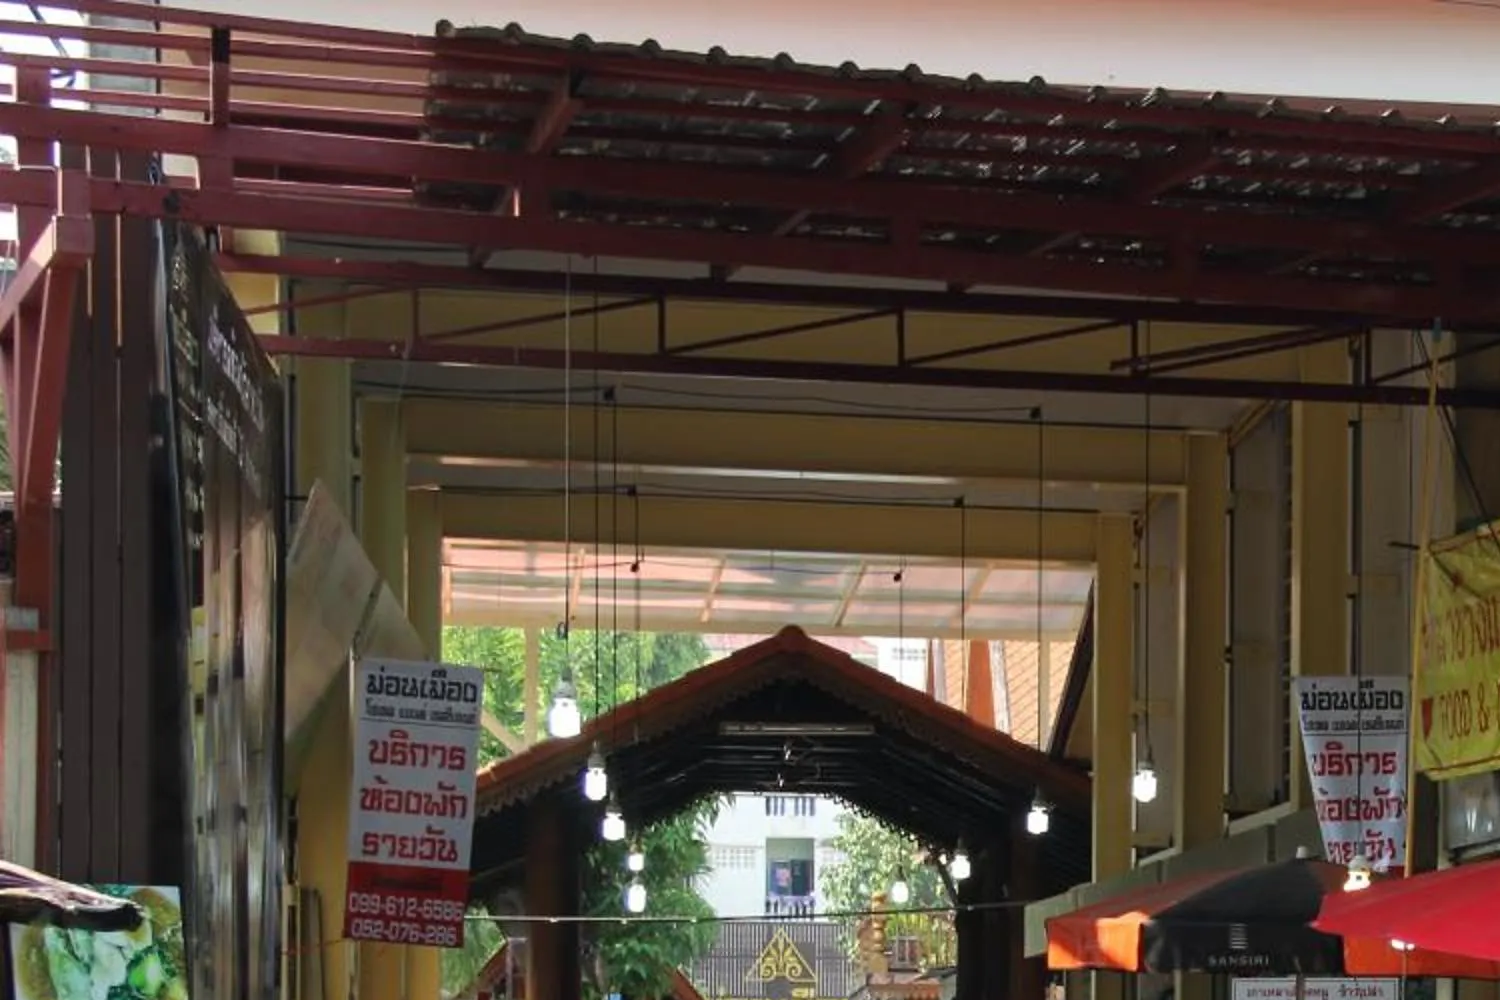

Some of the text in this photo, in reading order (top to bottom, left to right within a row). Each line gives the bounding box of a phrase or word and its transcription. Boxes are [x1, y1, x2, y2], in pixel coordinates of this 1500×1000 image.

[365, 665, 478, 703] ม่อนเมือง
[368, 729, 467, 771] บริการ
[359, 774, 468, 819] ห้องพัก
[361, 824, 459, 862] รายวัน
[1208, 955, 1269, 967] SANSIRI
